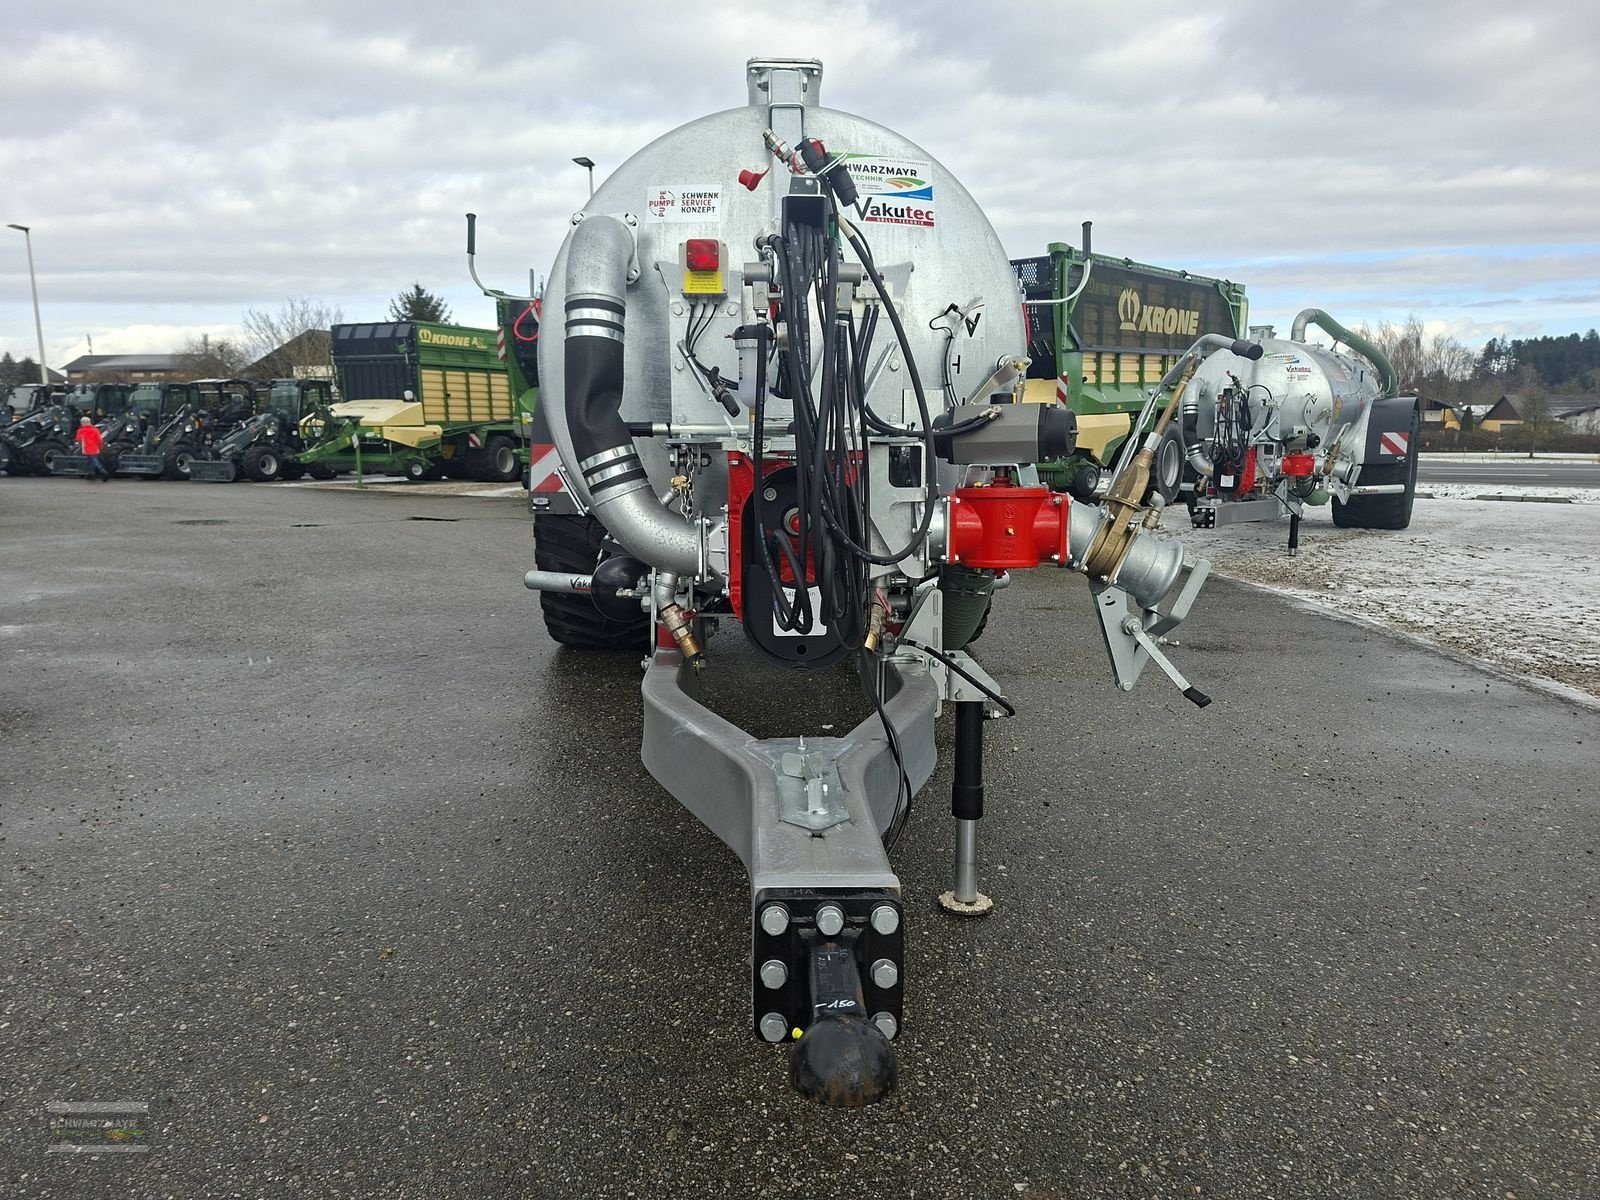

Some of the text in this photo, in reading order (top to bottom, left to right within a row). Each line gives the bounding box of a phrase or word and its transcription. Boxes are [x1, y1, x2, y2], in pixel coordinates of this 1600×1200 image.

[846, 163, 918, 178] HWARZMAYR
[851, 174, 884, 182] TECHNIK
[681, 192, 719, 200] SCHWENK
[681, 206, 716, 214] KONZEPT
[854, 197, 935, 221] Vakutec
[1138, 304, 1199, 336] KRONE
[431, 333, 470, 347] KRONE
